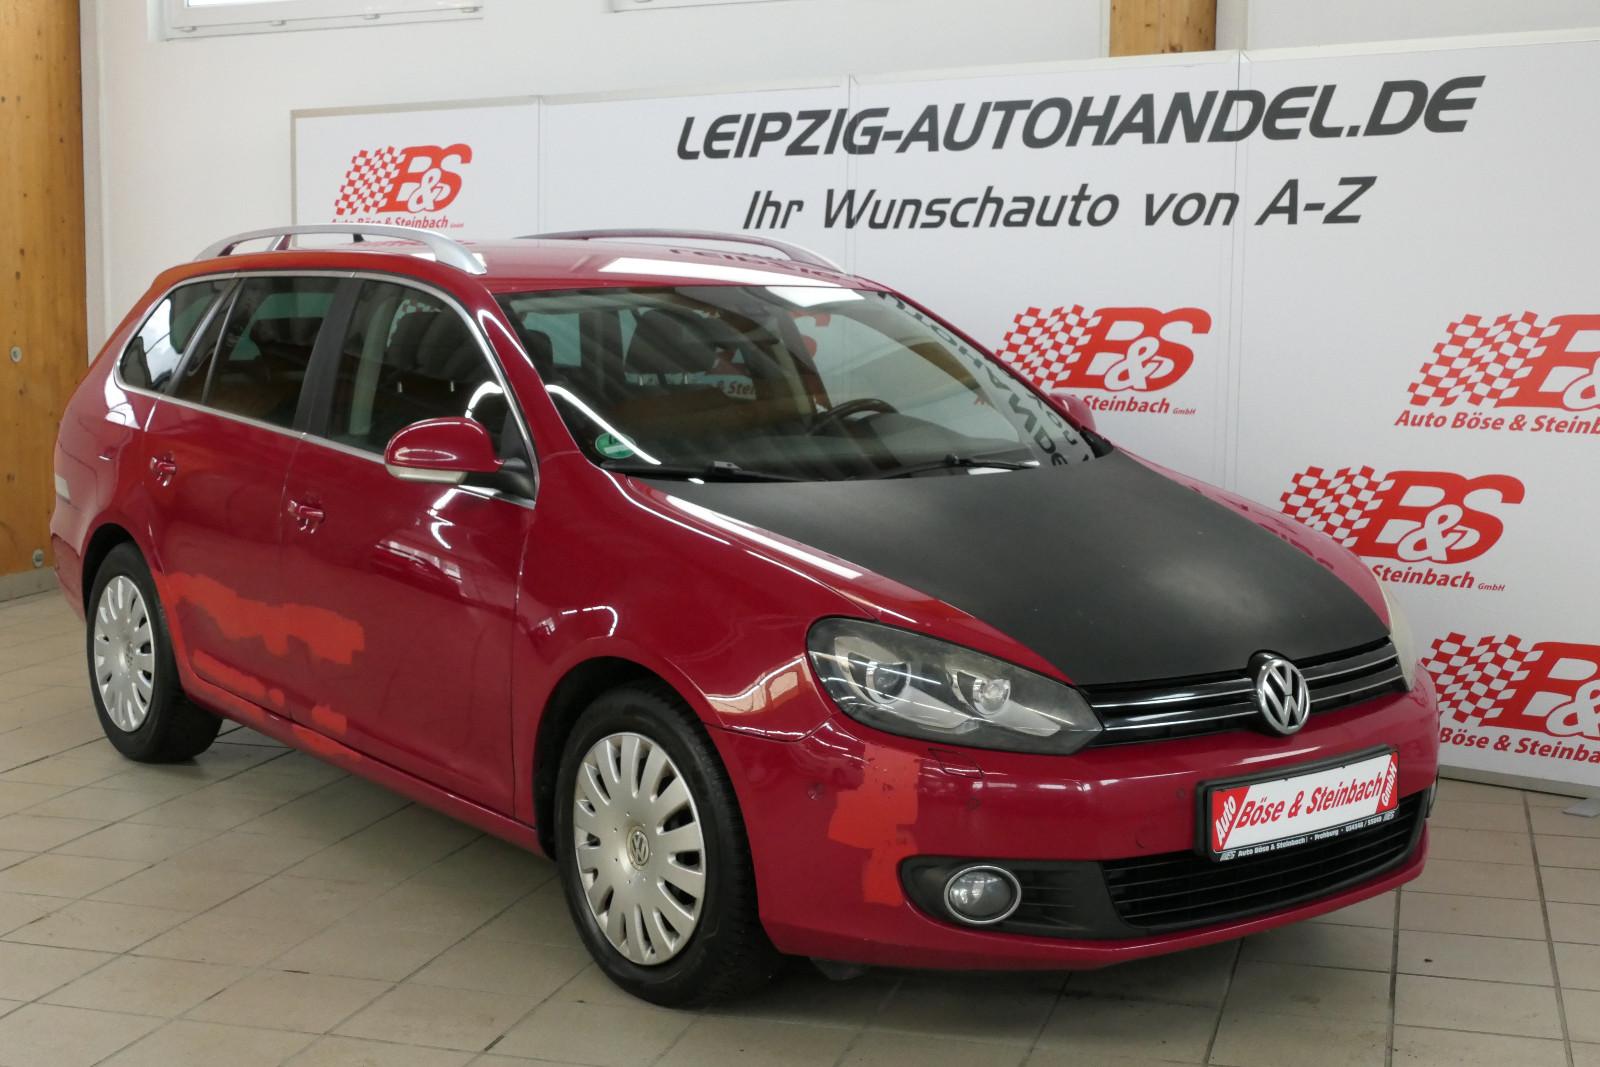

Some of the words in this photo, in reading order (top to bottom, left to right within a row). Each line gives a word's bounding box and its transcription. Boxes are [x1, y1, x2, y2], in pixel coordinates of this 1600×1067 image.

[676, 75, 1486, 160] LEIPZIG-AUTOHANDEL.DE
[743, 190, 804, 230] Ihr
[823, 183, 1120, 230] Wunschauto
[1144, 192, 1240, 227] von
[1254, 176, 1378, 226] A-Z
[1172, 407, 1196, 415] GmbH
[1393, 409, 1448, 428] Auto
[1450, 412, 1505, 431] Böse
[1508, 414, 1528, 432] &
[1478, 582, 1506, 592] GmbH
[1439, 727, 1490, 749] Böse
[1493, 734, 1511, 752] &
[1215, 795, 1237, 847] Auto
[1235, 796, 1285, 829] Böse
[1288, 790, 1305, 819] &
[1306, 771, 1383, 815] Steinbach
[1381, 761, 1398, 807] GmbH
